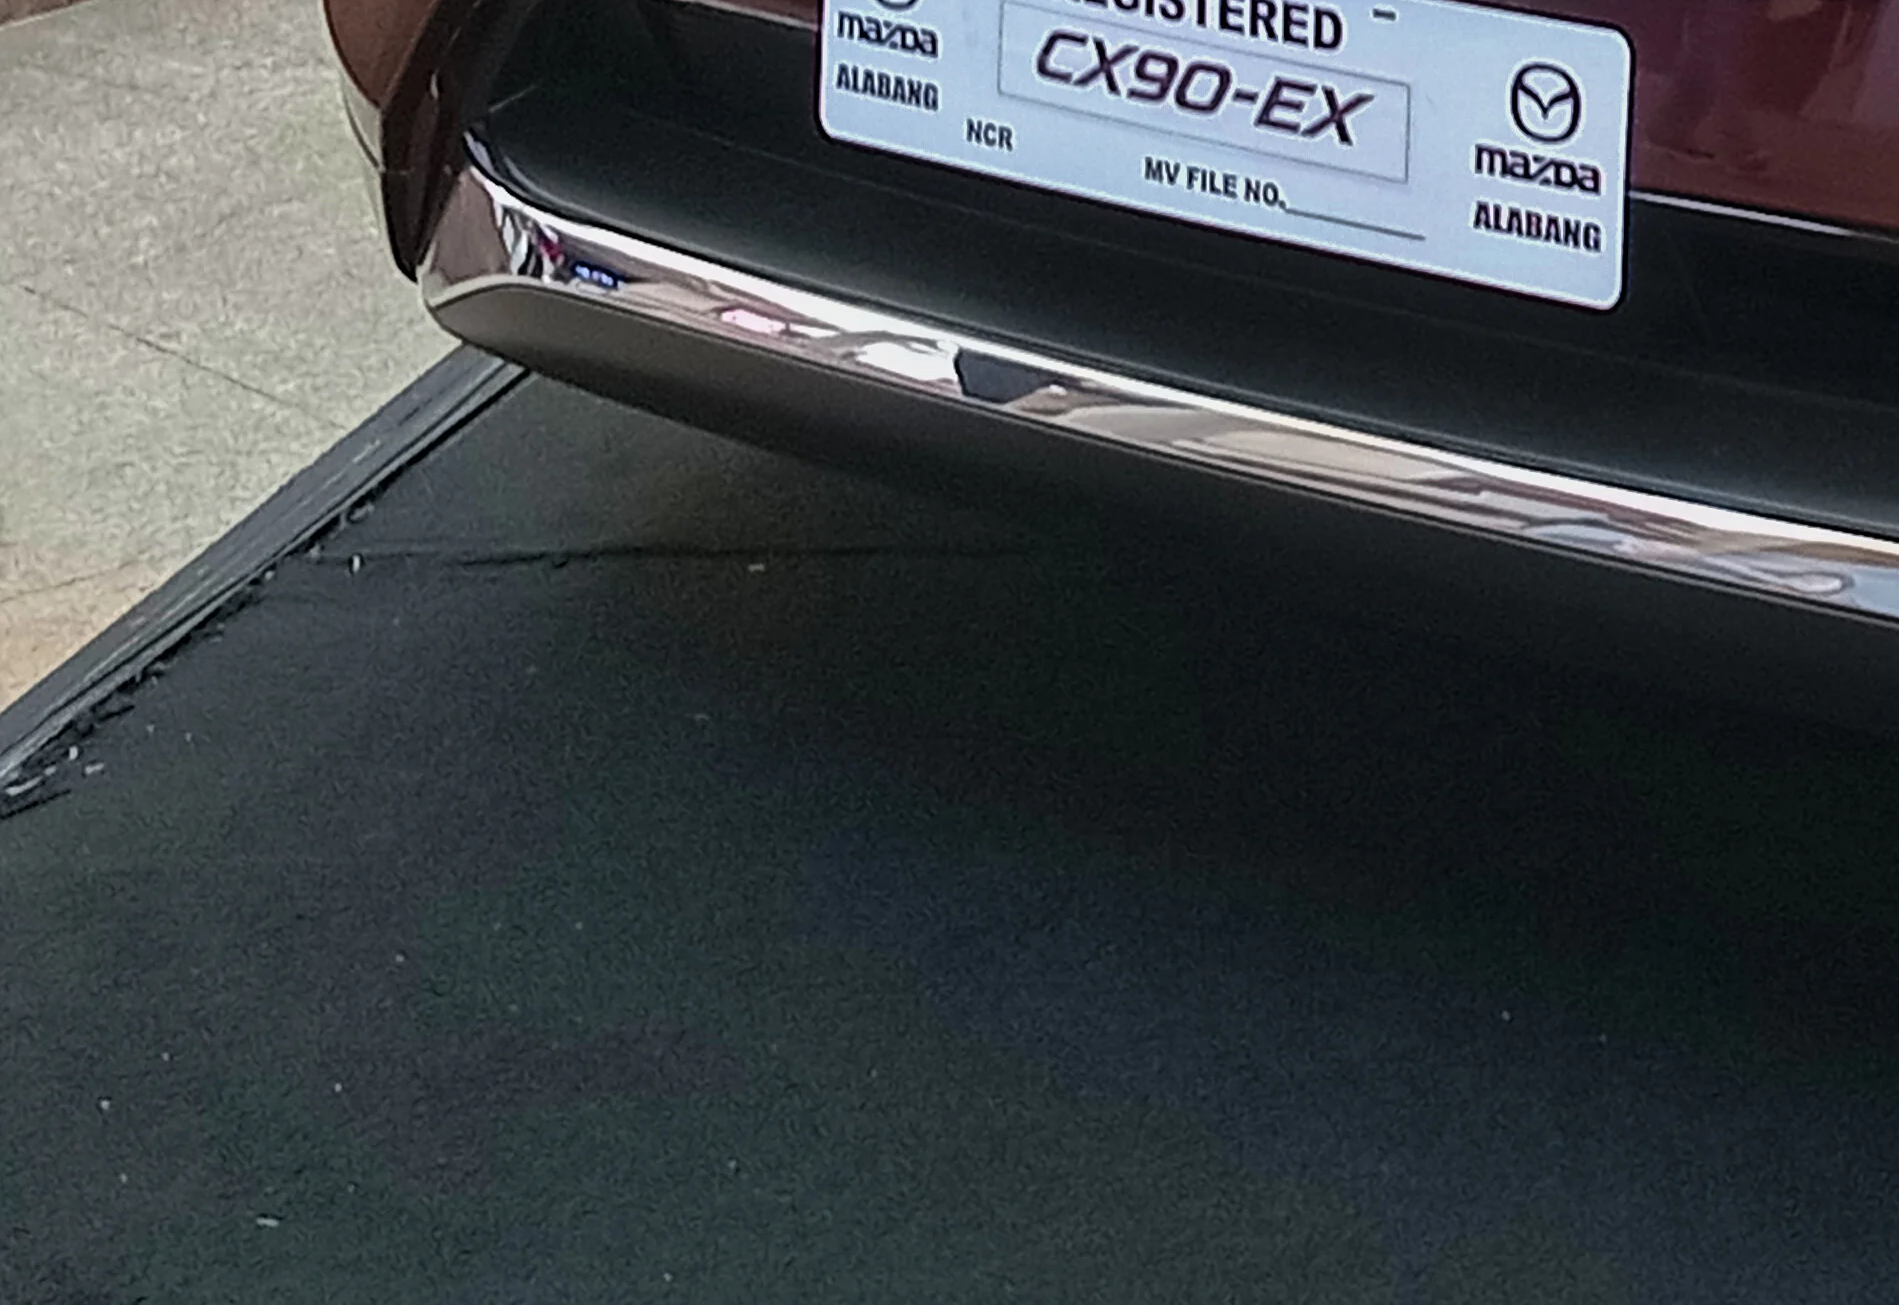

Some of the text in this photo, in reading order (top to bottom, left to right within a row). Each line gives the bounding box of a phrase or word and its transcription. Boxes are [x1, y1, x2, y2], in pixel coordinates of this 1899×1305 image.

[836, 62, 939, 111] ALABANG
[1036, 28, 1376, 146] CX90-EX
[966, 117, 1014, 151] NCR
[1144, 156, 1181, 186] MV
[1186, 165, 1238, 198] FILE
[1473, 200, 1602, 253] ALABANG
